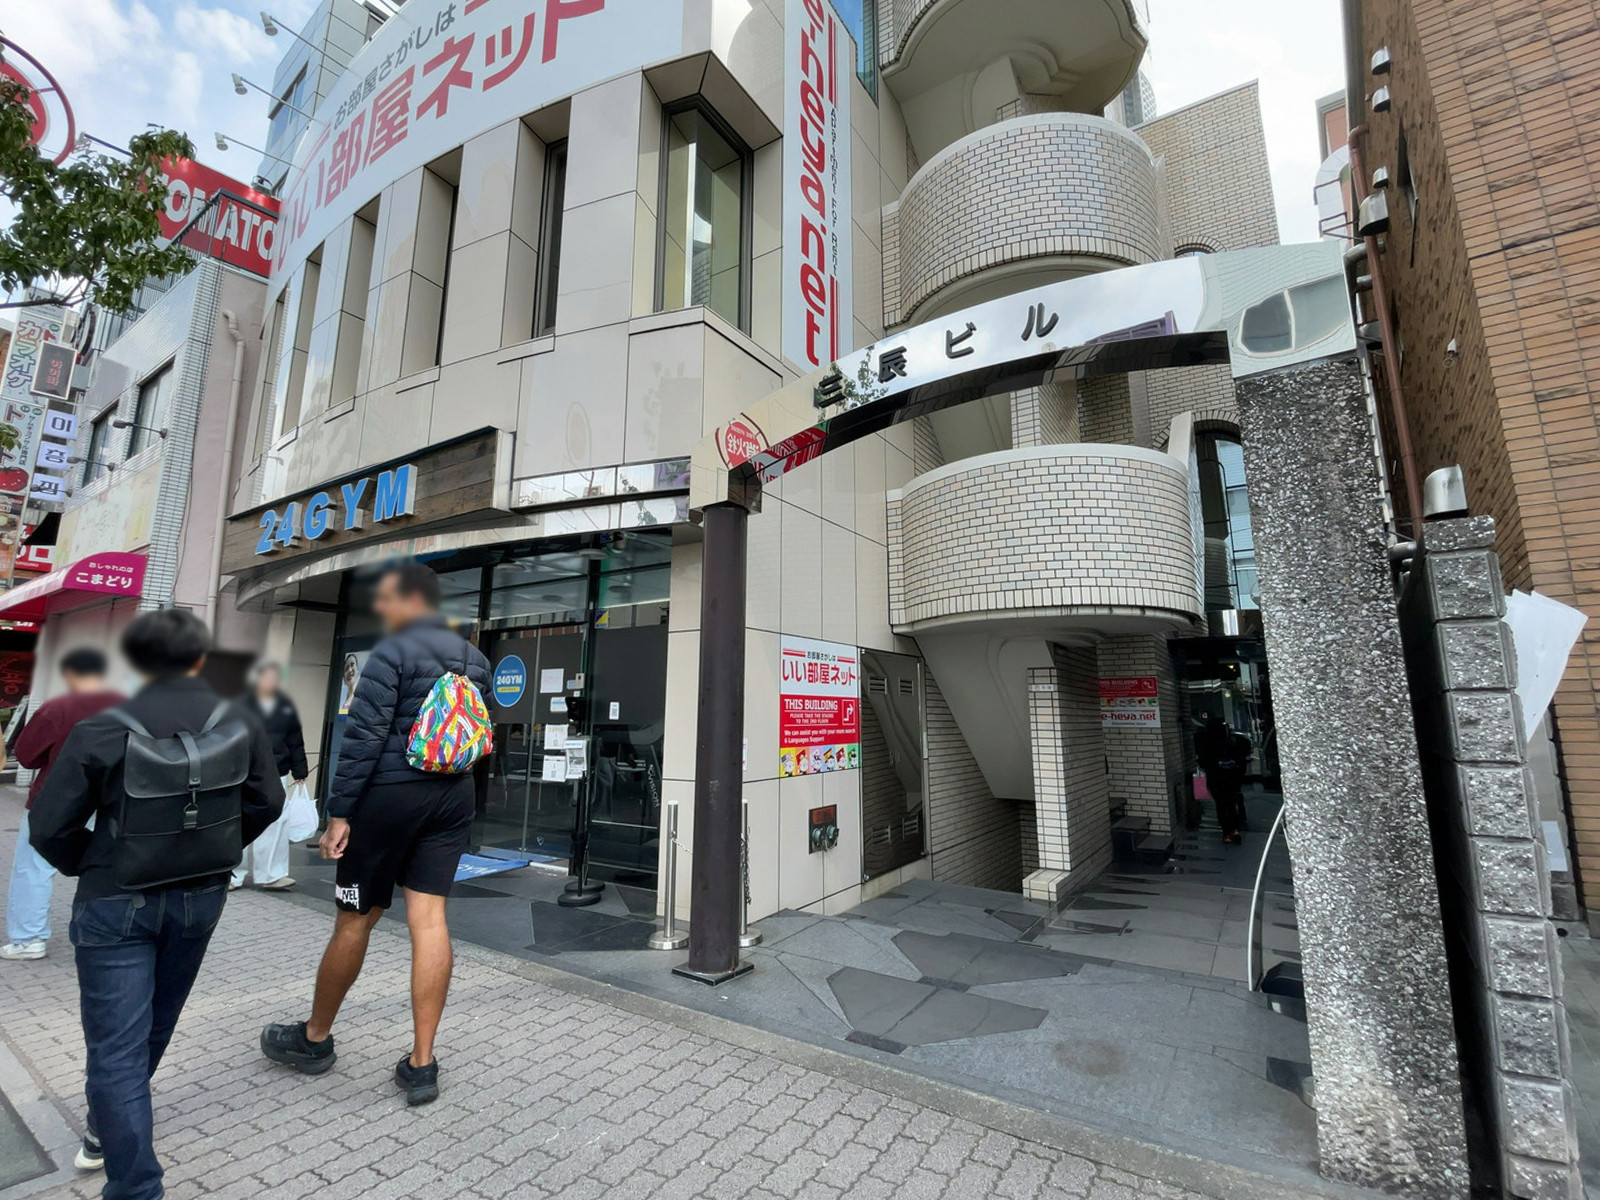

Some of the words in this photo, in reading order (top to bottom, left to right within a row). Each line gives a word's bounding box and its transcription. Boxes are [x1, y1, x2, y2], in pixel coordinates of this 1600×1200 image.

[334, 2, 457, 131] お部屋さがしは
[276, 0, 605, 273] いい部屋ネット
[159, 173, 277, 261] OMATO
[6, 320, 44, 389] カラオケ
[814, 302, 1059, 409] 三辰ビル
[254, 464, 417, 555] 24GYM
[75, 571, 133, 589] こまどり
[782, 658, 856, 687] いい部屋ネット
[784, 698, 803, 710] THIS
[804, 699, 838, 711] BUILDING
[1101, 711, 1156, 721] e-heya.net
